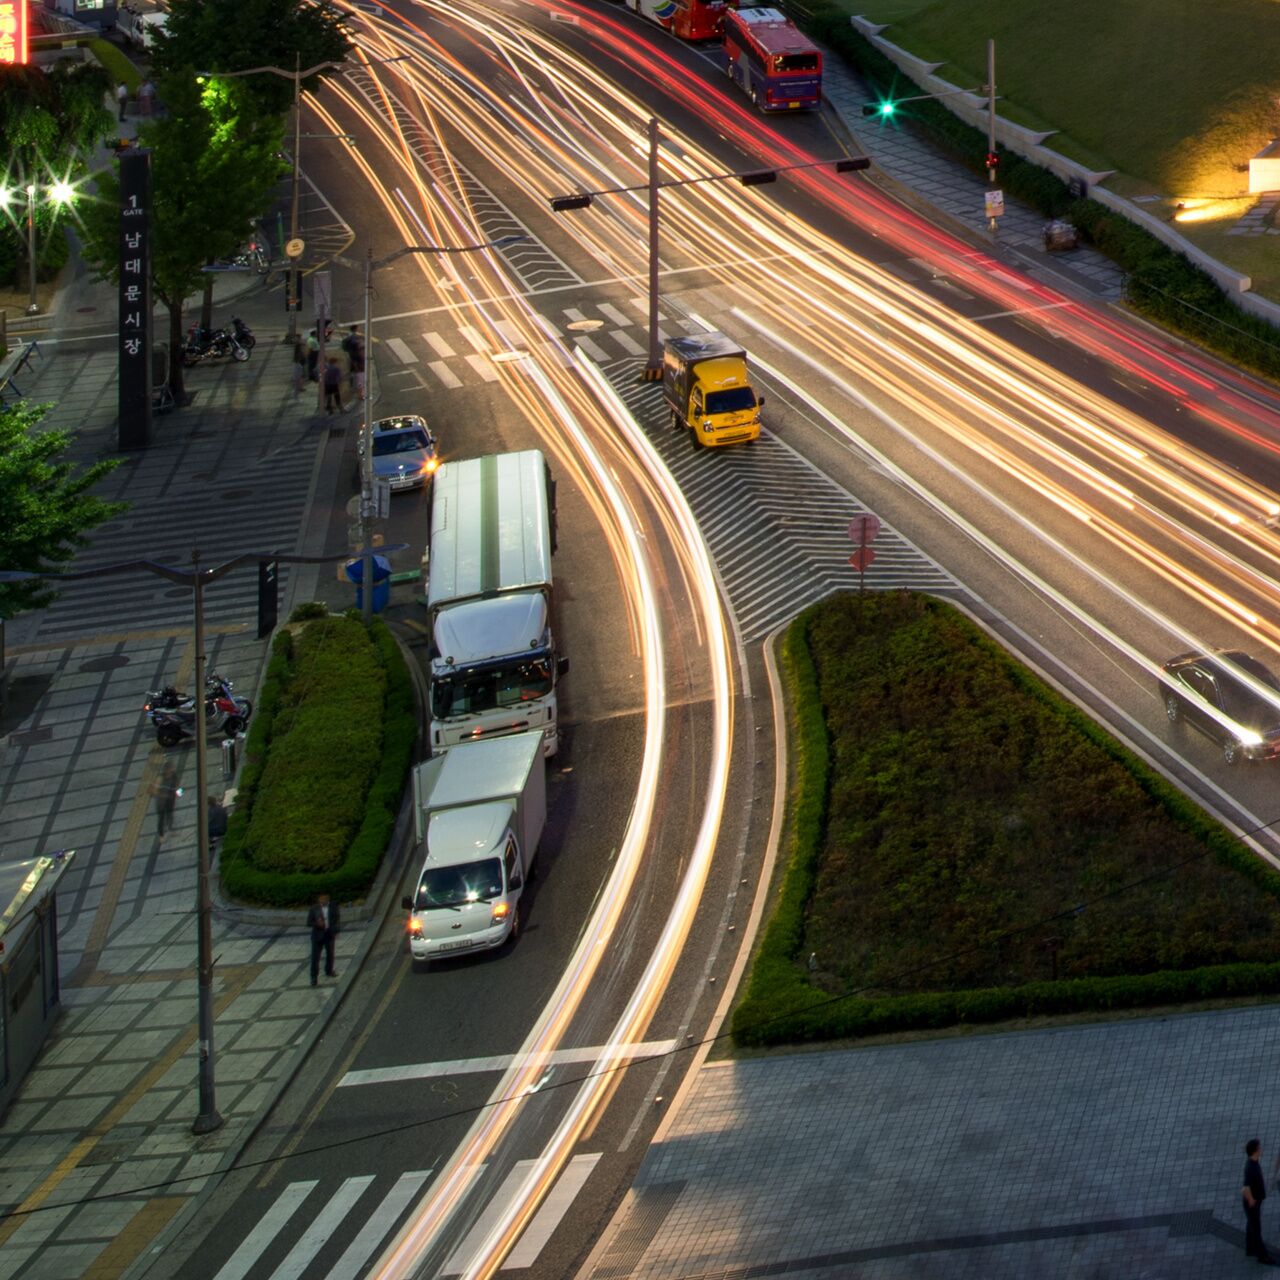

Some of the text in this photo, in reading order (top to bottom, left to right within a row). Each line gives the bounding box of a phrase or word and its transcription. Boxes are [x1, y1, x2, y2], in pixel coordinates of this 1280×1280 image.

[128, 194, 137, 208] 1
[123, 208, 143, 216] GATE
[125, 232, 142, 355] 남대문시장
